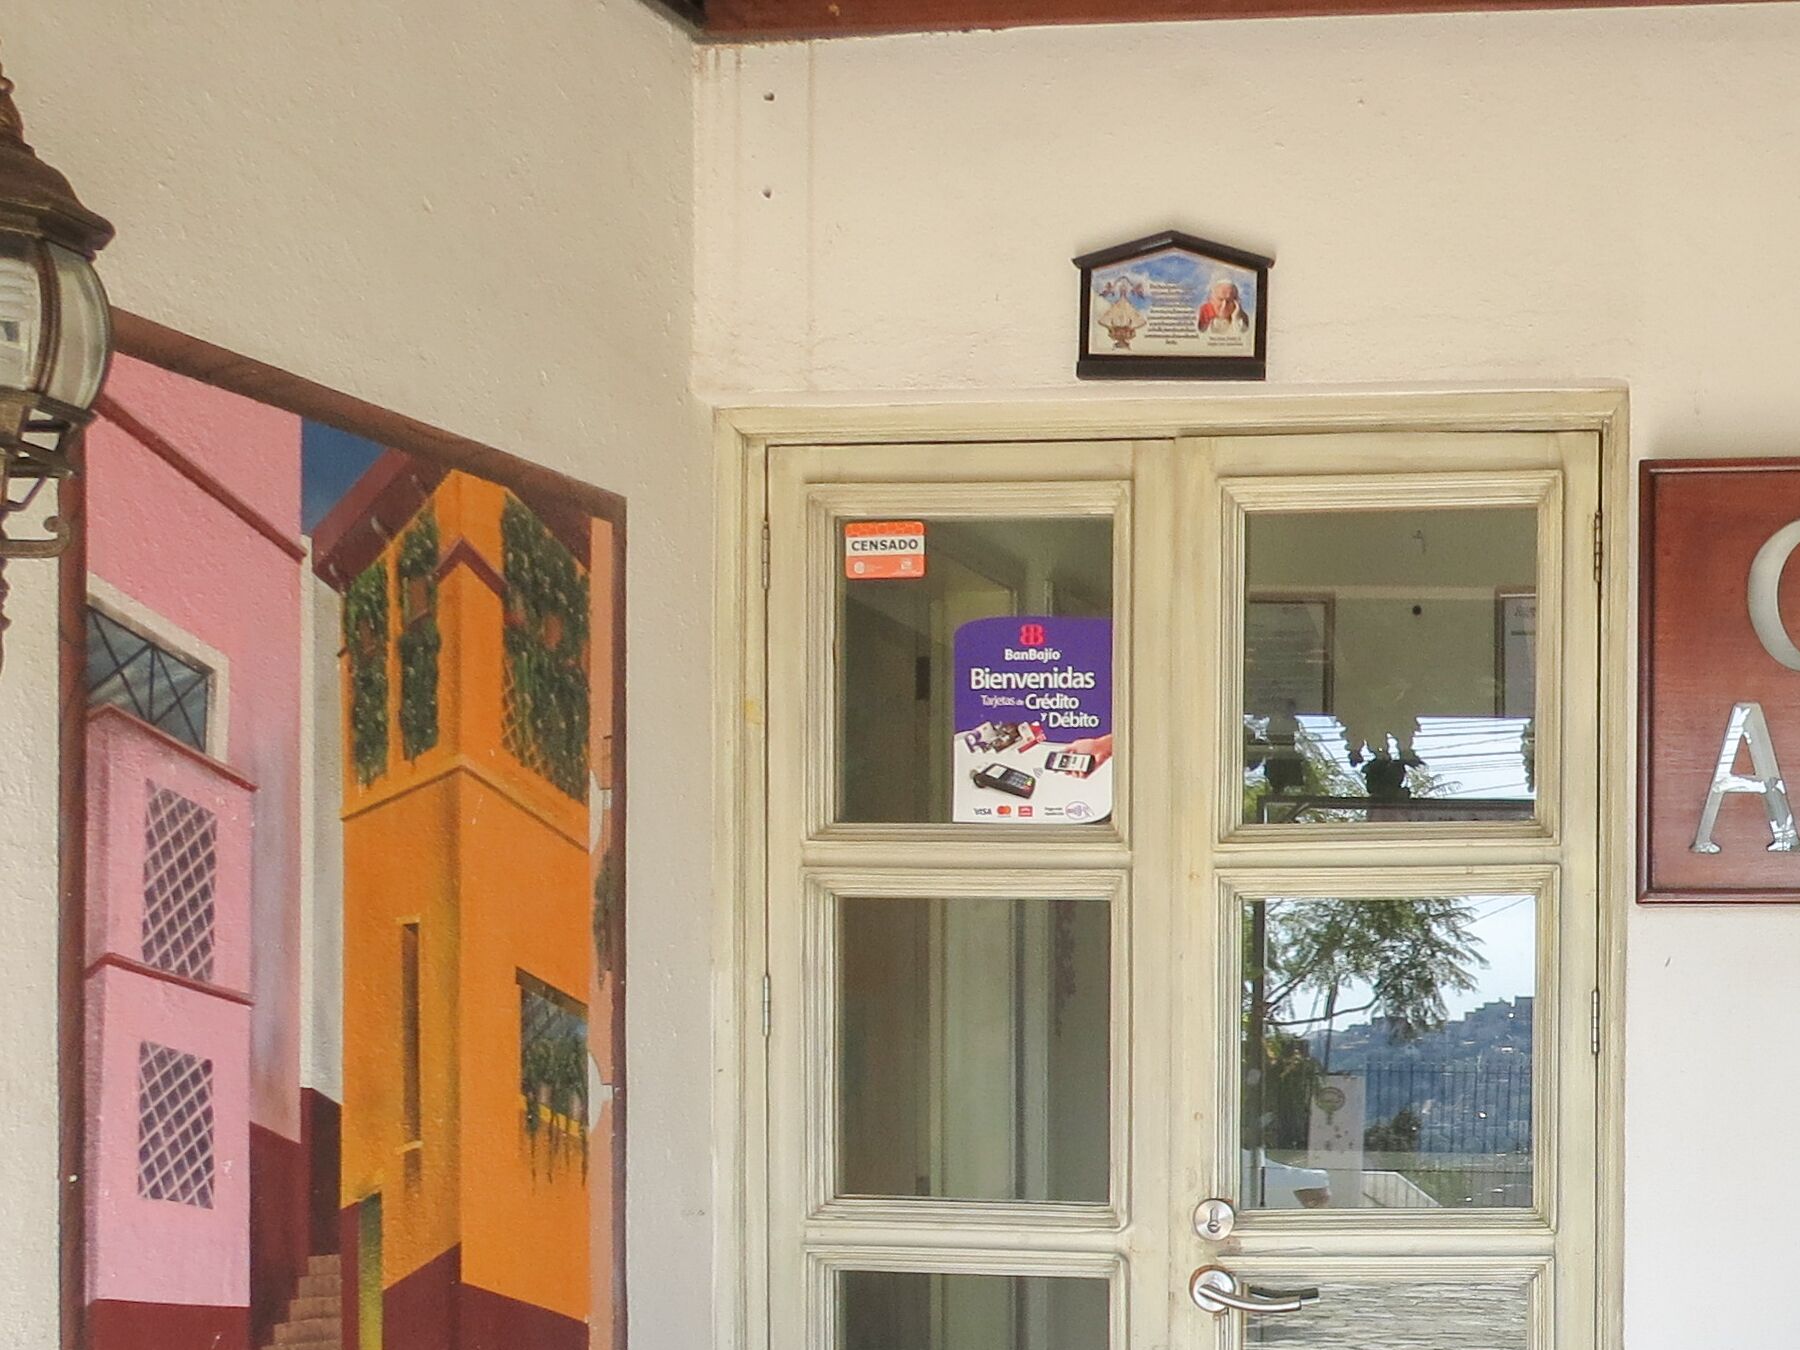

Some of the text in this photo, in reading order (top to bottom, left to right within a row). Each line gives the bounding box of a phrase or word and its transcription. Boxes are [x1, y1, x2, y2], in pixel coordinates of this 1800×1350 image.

[851, 539, 918, 551] CENSADO
[970, 666, 1095, 690] Bienvenidas
[980, 695, 1016, 708] Tarjetas
[1025, 694, 1080, 710] Crédito
[1049, 712, 1099, 728] Débito
